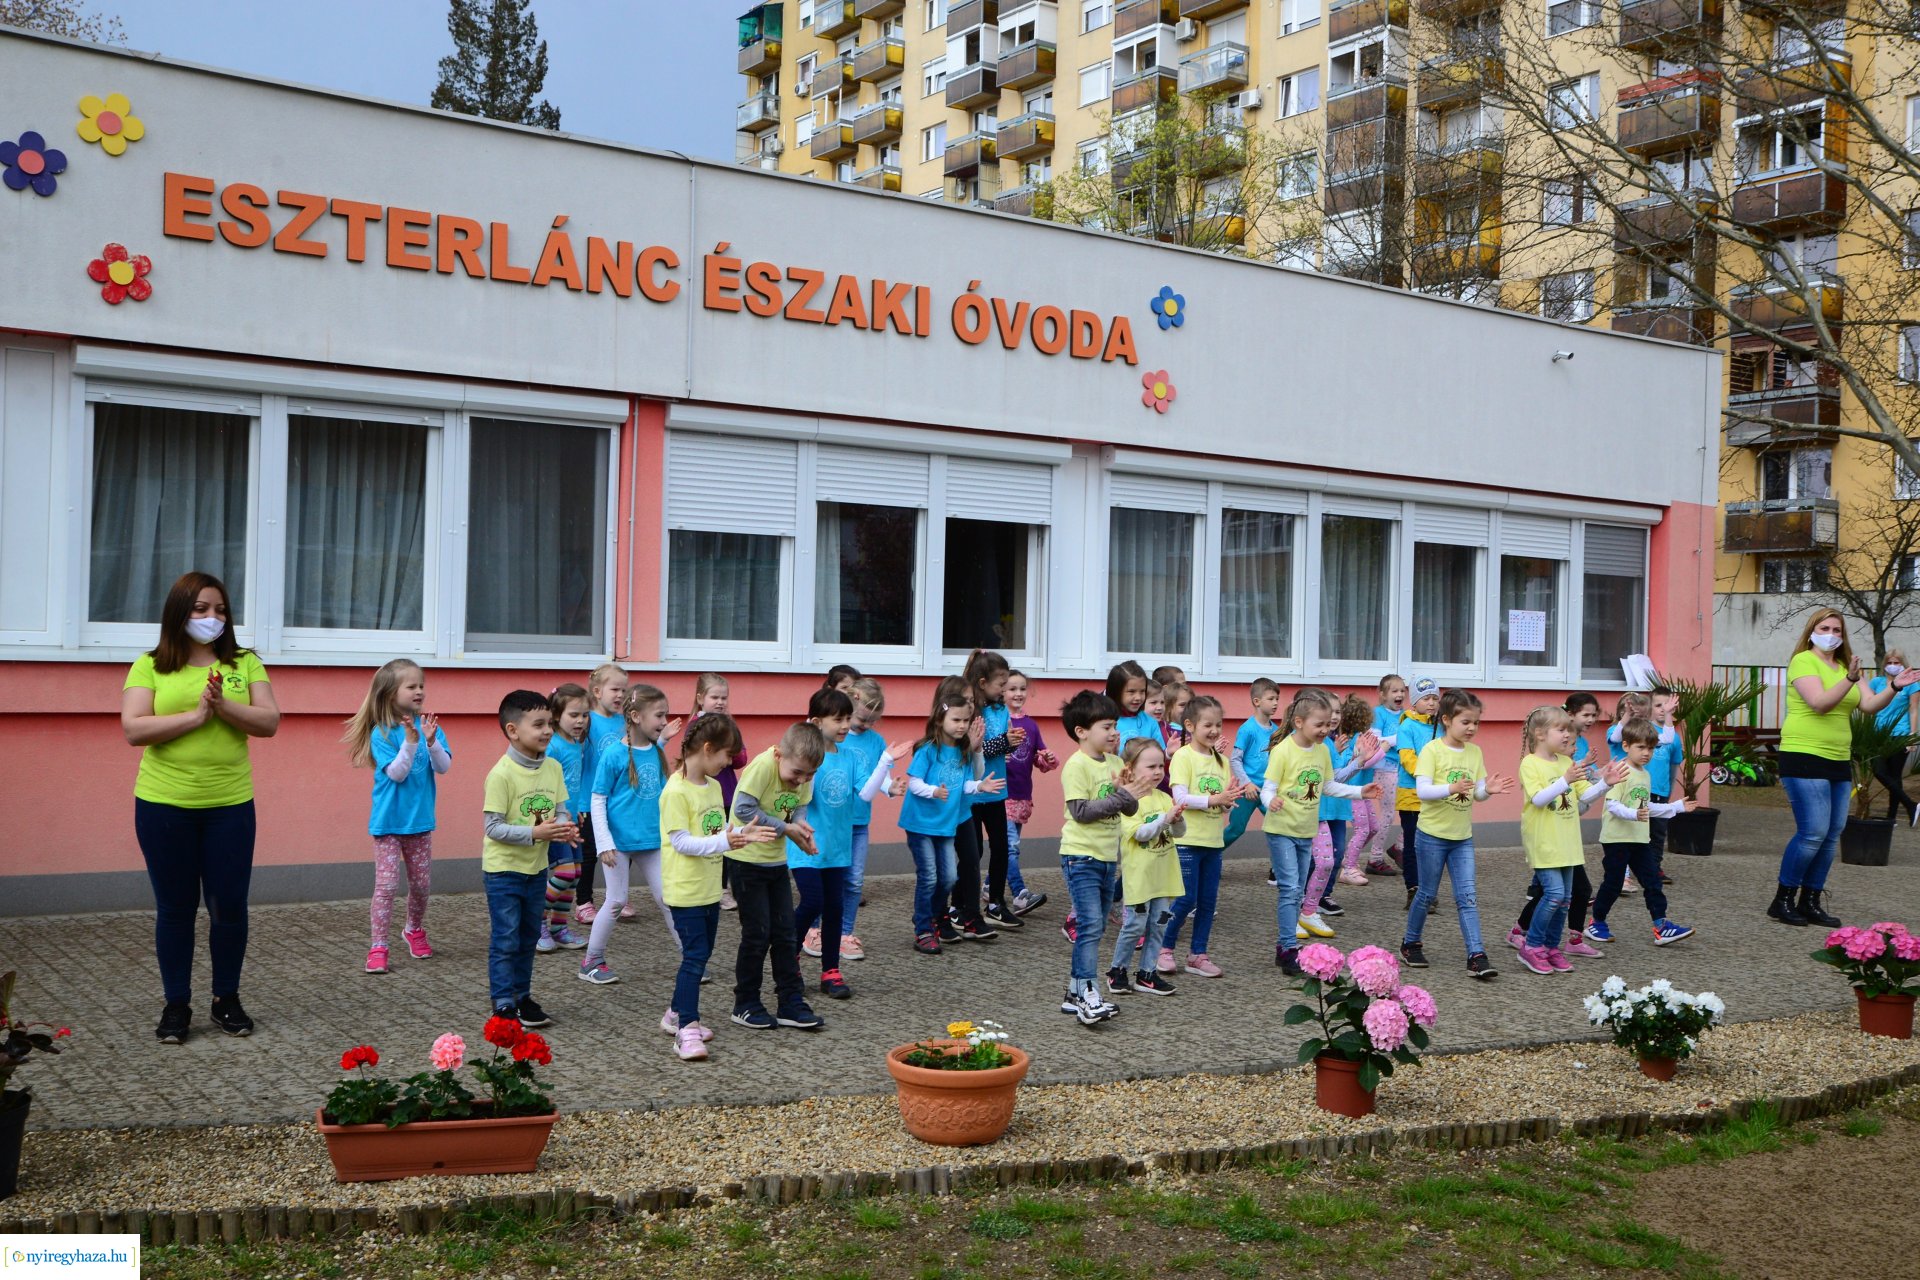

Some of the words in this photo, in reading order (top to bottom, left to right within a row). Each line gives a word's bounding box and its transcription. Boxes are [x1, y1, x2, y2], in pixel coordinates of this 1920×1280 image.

[163, 172, 682, 303] ESZTERLÁNC
[704, 241, 931, 338] ÉSZAKI
[952, 280, 1139, 365] ÓVODA
